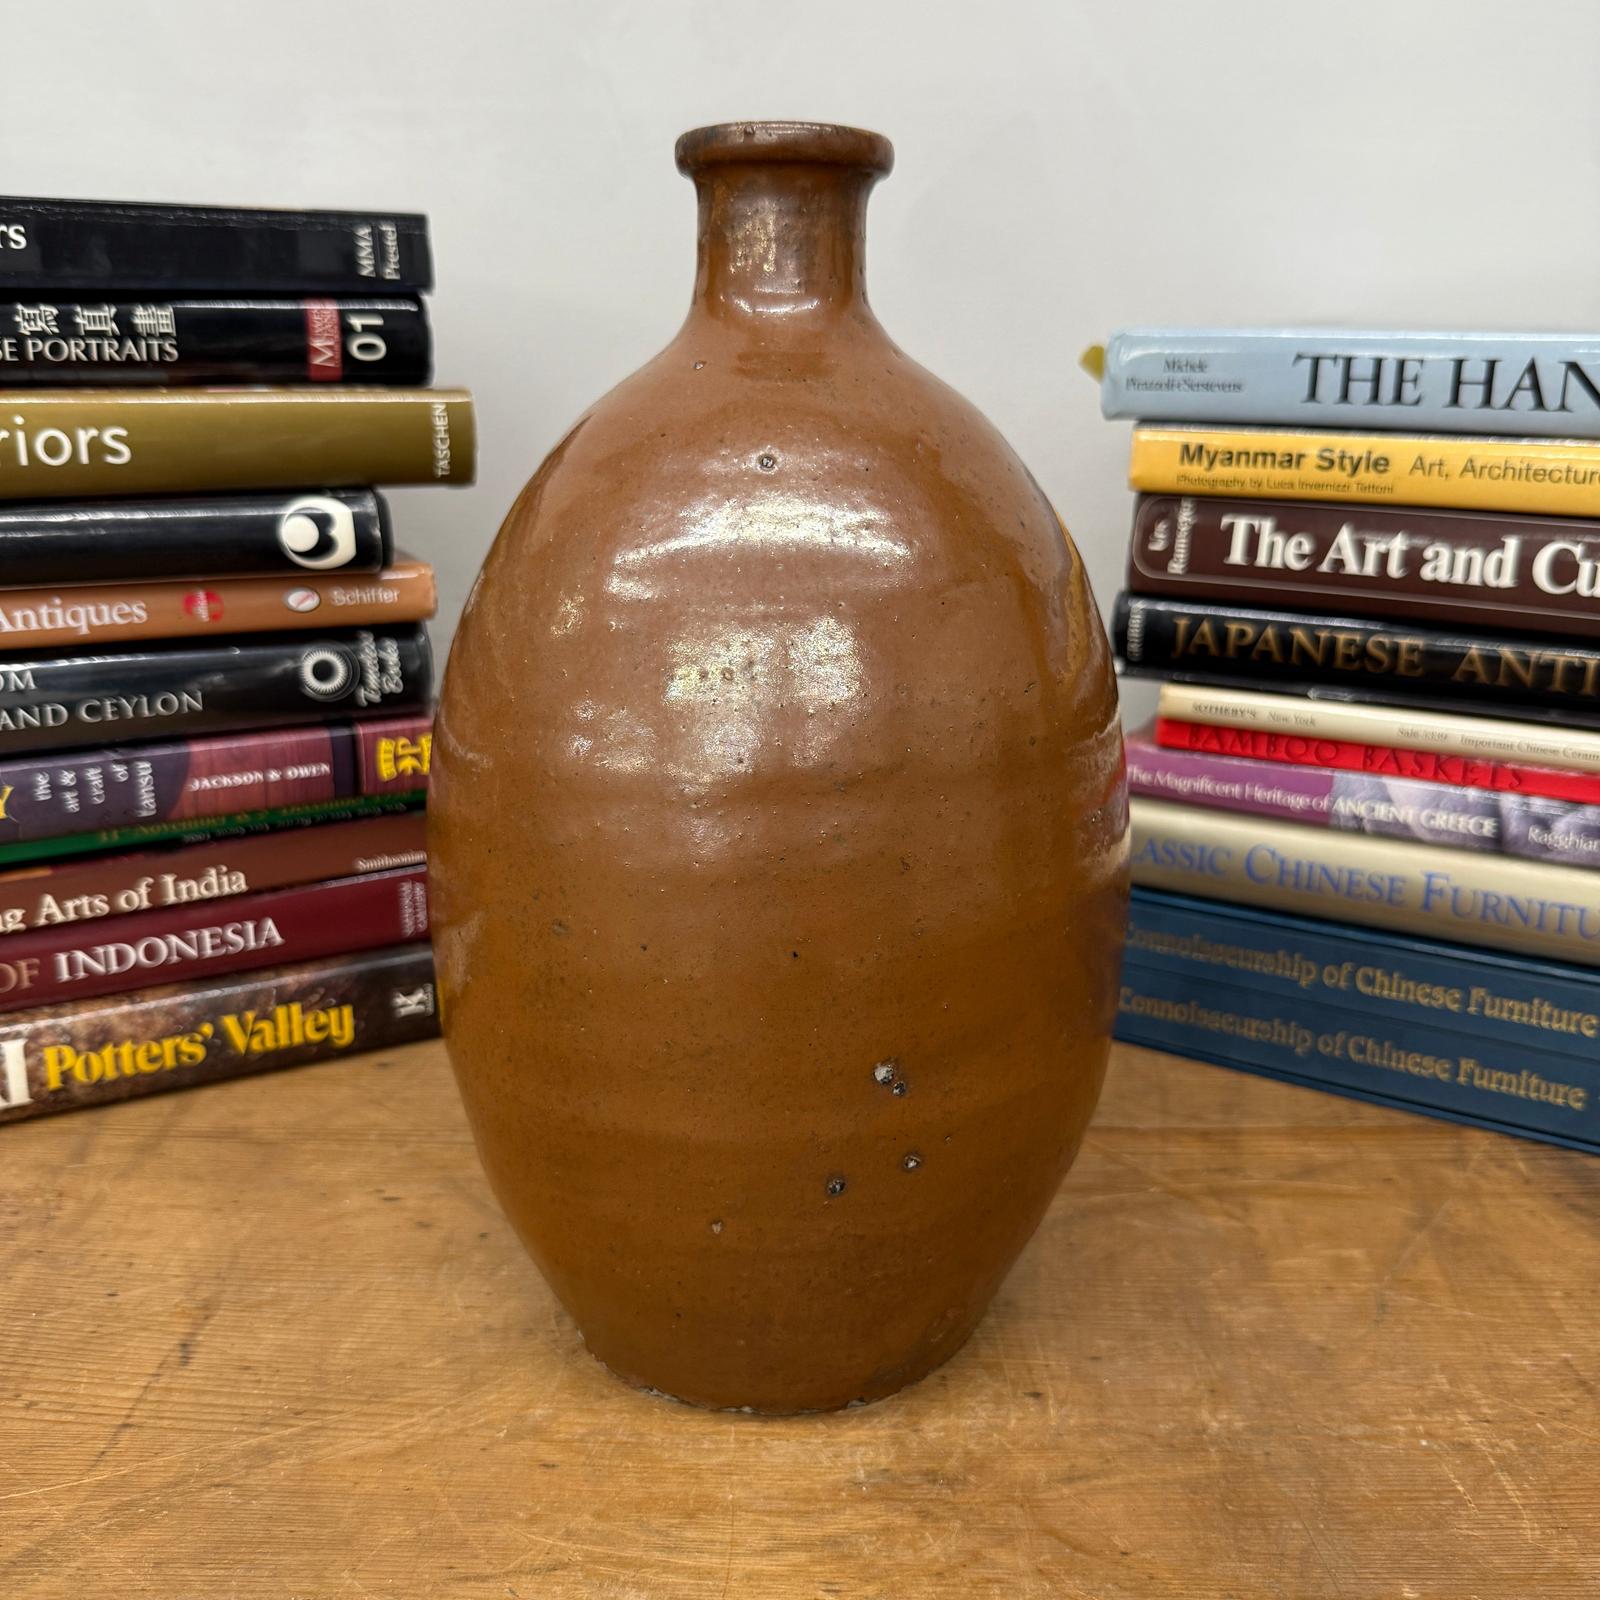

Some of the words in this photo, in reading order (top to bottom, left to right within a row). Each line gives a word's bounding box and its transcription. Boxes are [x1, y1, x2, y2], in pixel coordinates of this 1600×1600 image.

[353, 224, 377, 277] MMA
[0, 338, 21, 365] E
[26, 336, 179, 363] PORTRAITS
[346, 312, 387, 362] 01
[1293, 352, 1426, 406] THE
[433, 403, 451, 478] TASCHEN
[1179, 442, 1305, 471] Myanmar
[1315, 447, 1391, 477] Style
[1409, 455, 1450, 480] Art,
[1459, 456, 1600, 487] Architectur
[1176, 474, 1245, 489] Photography
[1249, 477, 1263, 489] by
[1266, 478, 1295, 491] Luca
[1220, 513, 1314, 570] The
[1317, 521, 1417, 579] Art
[1422, 534, 1521, 589] and
[0, 597, 148, 634] Antiques
[331, 586, 400, 607] Schiffer
[0, 671, 37, 692] M
[1171, 616, 1427, 678] JAPANESE
[1450, 643, 1600, 697] ANTI
[0, 703, 69, 731] AND
[76, 689, 204, 724] CEYLON
[1267, 710, 1289, 723] New
[1293, 713, 1316, 728] York
[1185, 722, 1338, 766] BAMBOO
[1362, 744, 1522, 790] BASKETS
[1460, 734, 1514, 752] Important
[1516, 741, 1560, 755] Chinese
[60, 769, 77, 787] &
[188, 770, 264, 792] JACKSON
[266, 767, 283, 782] &
[286, 762, 330, 780] OWEN
[1153, 769, 1241, 799] Magnificent
[1244, 783, 1311, 811] Heritage
[1311, 794, 1329, 812] of
[1332, 796, 1414, 824] ANCIENT
[1418, 807, 1498, 838] GREECE
[35, 893, 110, 927] Arts
[116, 875, 155, 913] of
[159, 864, 249, 903] India
[1130, 837, 1232, 876] ASSIC
[1245, 842, 1406, 907] CHINESE
[53, 917, 286, 984] INDONESIA
[1322, 962, 1352, 990] of
[1355, 966, 1461, 1011] Chinese
[1467, 986, 1599, 1039] Furniture
[43, 1022, 214, 1092] Potters'
[219, 1001, 356, 1057] Valley
[1118, 986, 1314, 1055] Connoisseurship
[1317, 1029, 1349, 1058] of
[1348, 1036, 1450, 1082] Chinese
[1457, 1056, 1588, 1110] Furniture
